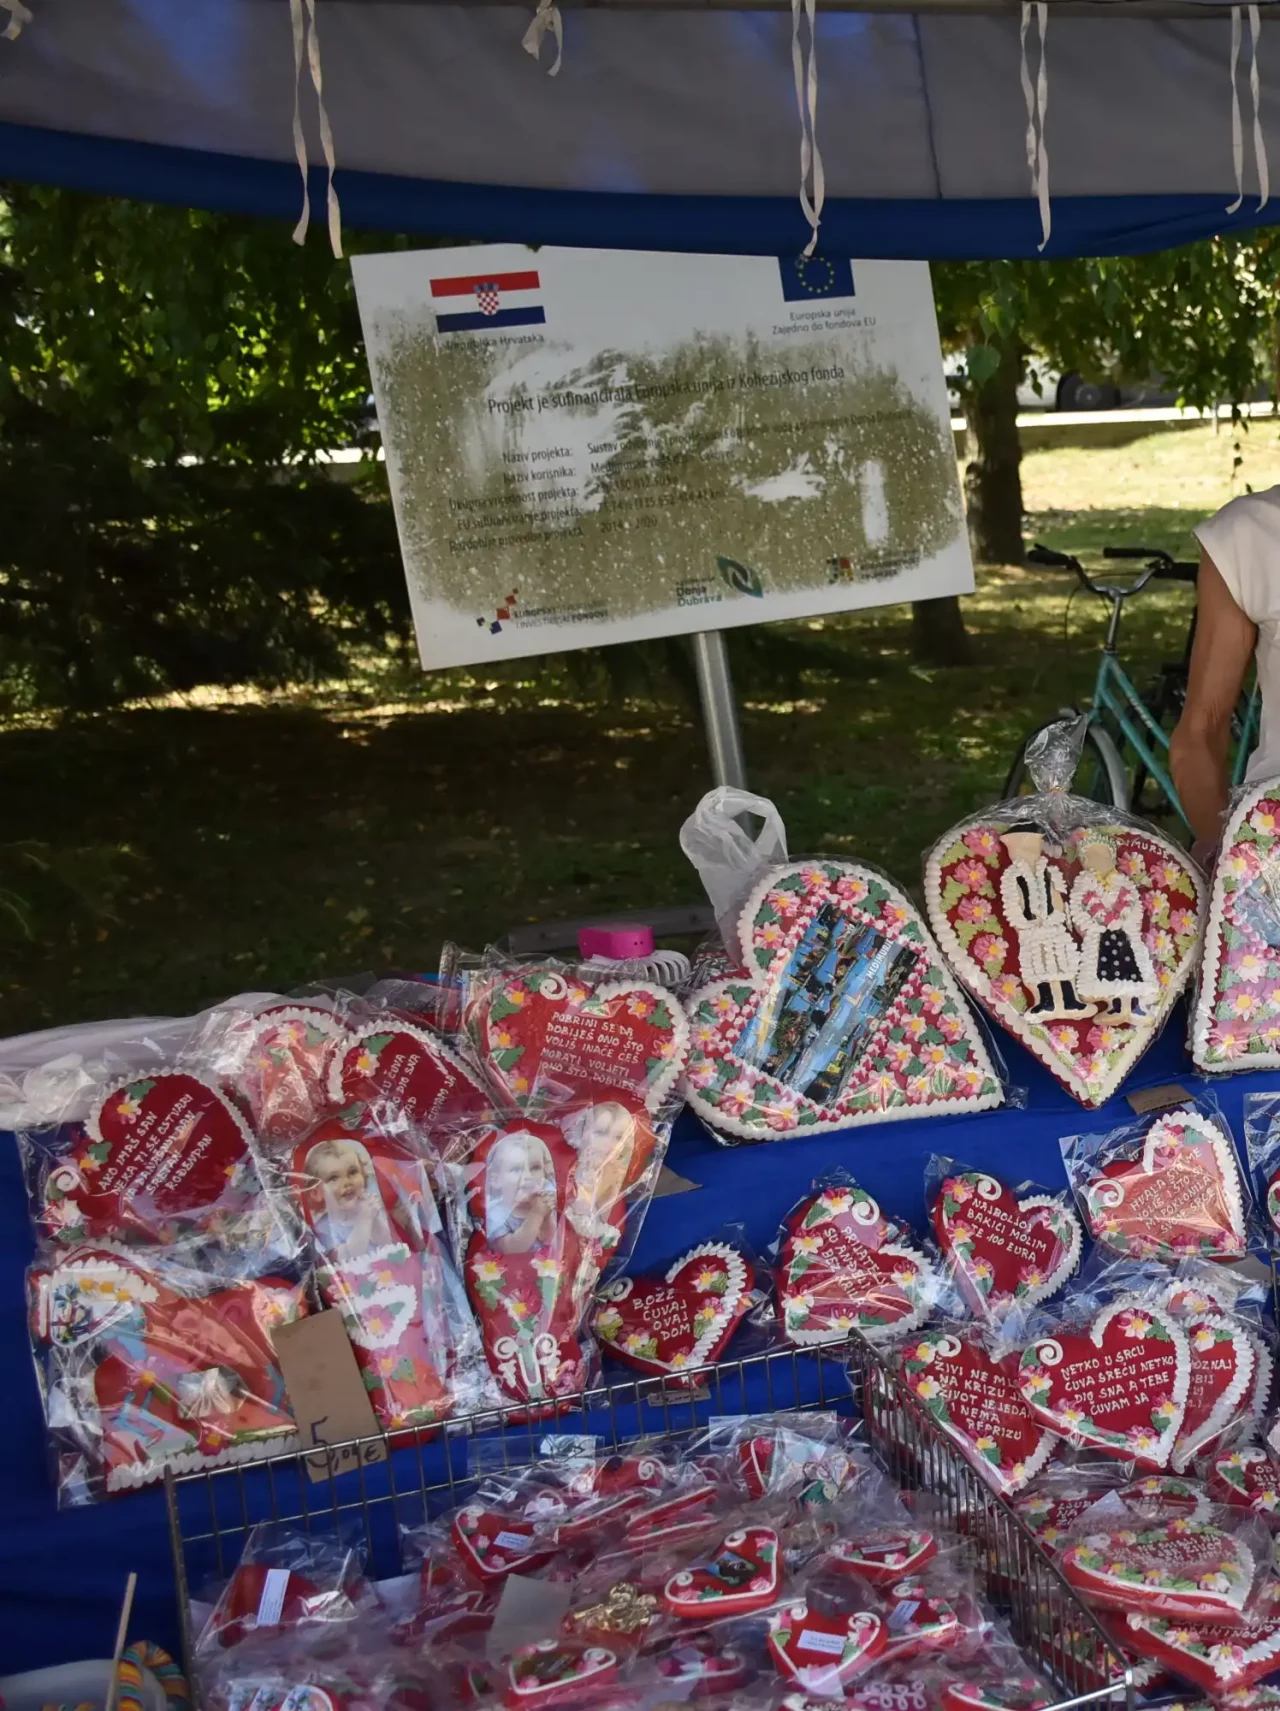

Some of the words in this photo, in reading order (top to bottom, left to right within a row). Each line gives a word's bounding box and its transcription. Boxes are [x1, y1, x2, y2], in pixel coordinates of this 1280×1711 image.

[772, 323, 809, 336] Zajedno
[812, 321, 823, 332] do
[825, 319, 861, 331] fondova
[865, 316, 876, 327] EU
[790, 311, 831, 324] Europska
[834, 308, 856, 320] unija
[488, 397, 534, 415] Projekt
[537, 395, 550, 413] je
[552, 388, 633, 410] sufinancirala
[635, 381, 691, 401] Europska
[693, 379, 724, 394] unija
[726, 374, 736, 389] iz
[739, 368, 808, 389] Kohezijskog
[811, 364, 845, 381] fonda
[502, 450, 530, 464] Naziv
[532, 446, 574, 464] projekta:
[531, 467, 577, 482] korisnika:
[537, 487, 580, 503] projekta:
[546, 1021, 595, 1041] DOBIJEŠ
[597, 1034, 620, 1047] ONO
[622, 1036, 645, 1053] ŠTO
[551, 1011, 598, 1029] POBRINI
[601, 1021, 616, 1034] SE
[619, 1025, 634, 1038] DA
[544, 1034, 577, 1051] VOLIŠ
[581, 1043, 615, 1059] INAČE
[539, 1046, 582, 1066] MORATI
[588, 1058, 631, 1078] VOLJETI
[541, 1060, 563, 1073] ONO
[567, 1063, 588, 1079] ŠTO
[98, 1167, 118, 1191] AKO
[115, 1133, 140, 1166] IMAŠ
[136, 1110, 158, 1137] SAN
[122, 1187, 137, 1204] NA
[174, 1109, 196, 1135] DAN
[113, 1165, 138, 1196] NEKA
[133, 1151, 148, 1164] TI
[145, 1134, 160, 1151] SE
[145, 1149, 182, 1196] SRETAN
[1129, 1178, 1167, 1212] HVALA
[1160, 1175, 1212, 1218] POKLONILA
[971, 1198, 1032, 1233] NAJBOLJOJ
[824, 1227, 839, 1244] SU
[966, 1207, 1006, 1235] BAKICI
[1008, 1228, 1048, 1253] MOLIM
[970, 1223, 985, 1239] TE
[986, 1233, 1005, 1247] 100
[1006, 1241, 1037, 1264] EURA
[821, 1247, 841, 1273] BEZ
[632, 1286, 676, 1311] BOŽE
[642, 1298, 688, 1322] ČUVAJ
[652, 1310, 690, 1332] OVAJ
[660, 1322, 691, 1342] DOM
[933, 1355, 963, 1377] ŽIVI
[970, 1368, 989, 1382] NE
[1060, 1358, 1100, 1378] NETKO
[1103, 1354, 1113, 1367] U
[1115, 1343, 1146, 1365] SRCU
[1063, 1374, 1096, 1392] ČUVA
[1097, 1362, 1137, 1384] SREĆU
[1139, 1355, 1175, 1373] NETKO
[938, 1383, 979, 1405] ŽIVOT
[981, 1398, 997, 1411] JE
[939, 1373, 959, 1387] NA
[964, 1379, 1006, 1399] KRIZU
[1099, 1384, 1125, 1400] SNA
[1128, 1379, 1139, 1392] A
[1138, 1370, 1171, 1390] TEBE
[960, 1404, 1001, 1425] NEMA
[1089, 1398, 1131, 1417] ČUVAM
[1133, 1391, 1150, 1406] JA
[965, 1417, 1023, 1441] REPRIZU
